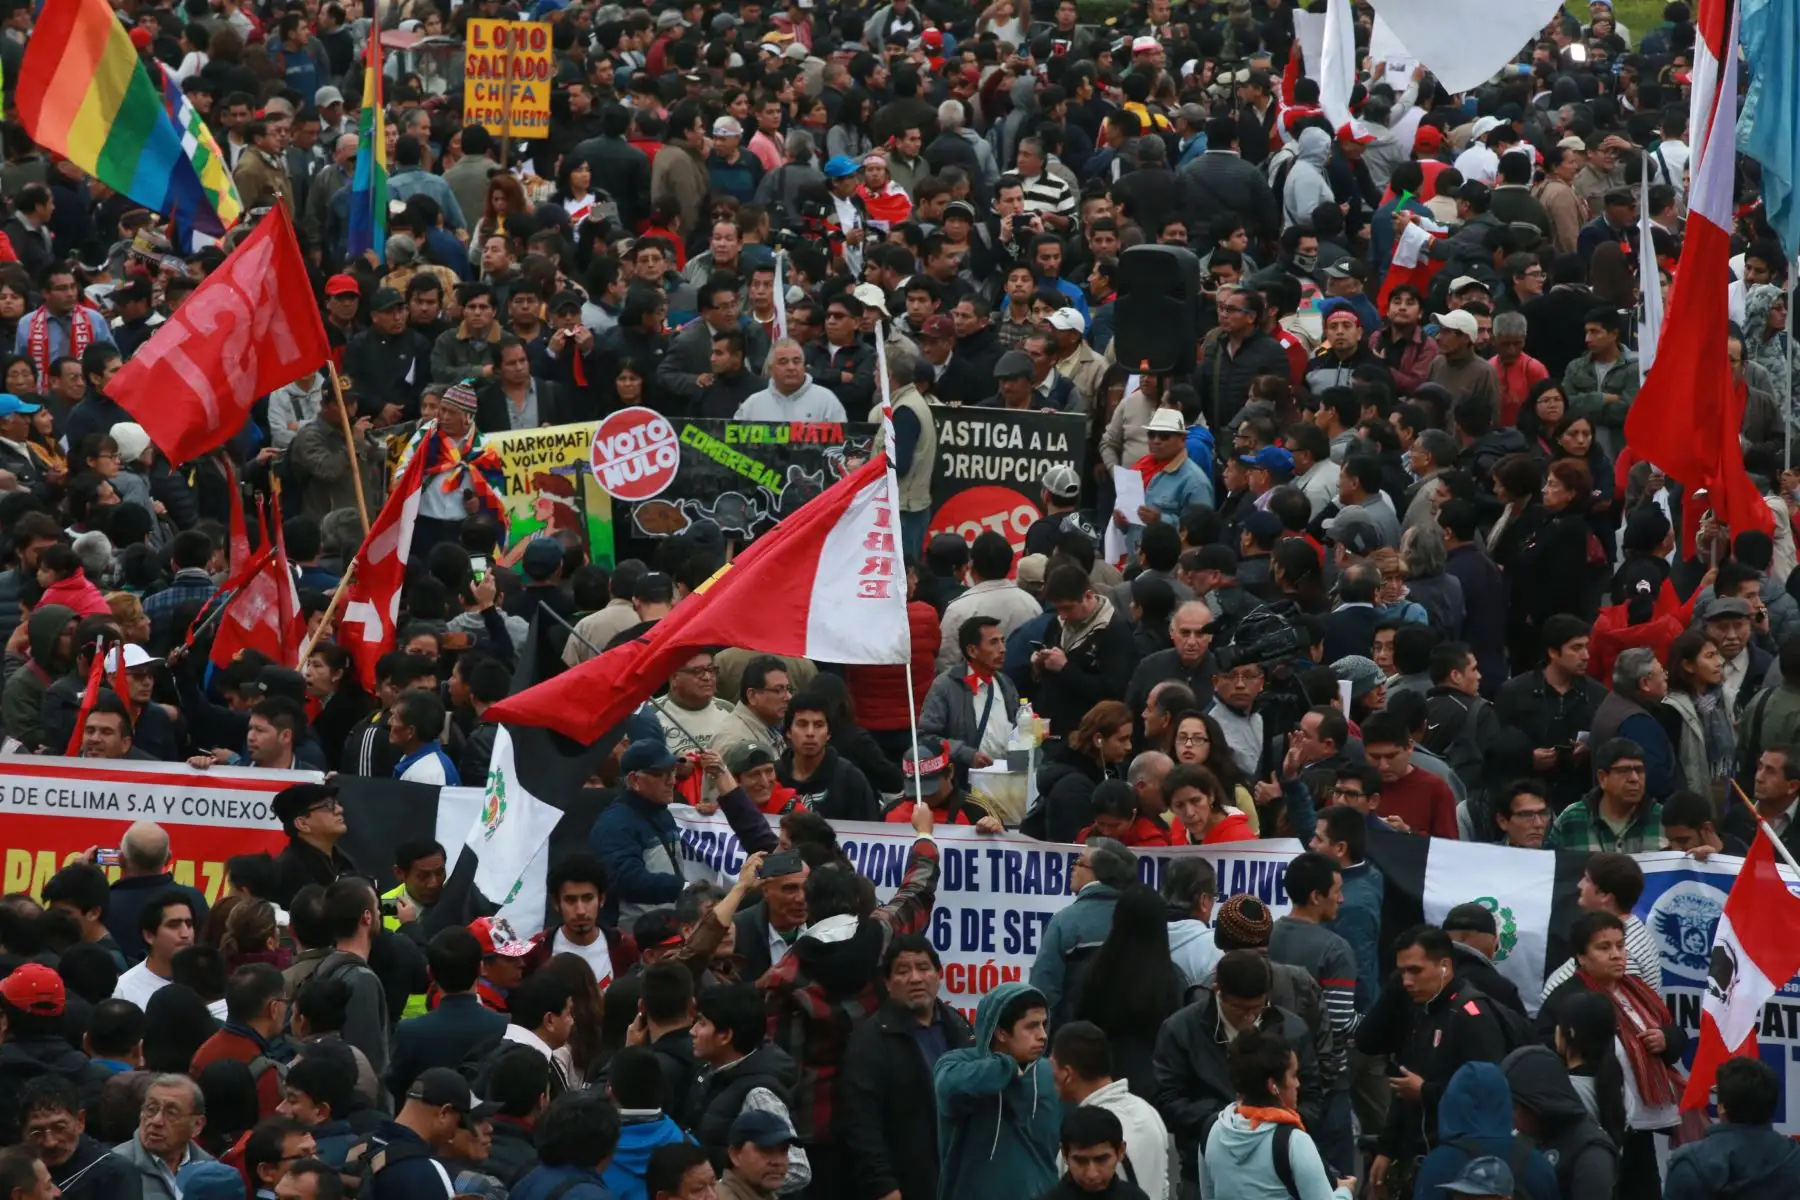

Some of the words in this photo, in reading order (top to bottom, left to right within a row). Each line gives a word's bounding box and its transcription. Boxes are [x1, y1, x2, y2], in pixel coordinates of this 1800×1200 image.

[466, 53, 549, 81] SALTADO
[465, 108, 551, 126] AEROUERTO
[502, 431, 591, 455] NARKOMAFI
[596, 418, 669, 463] VOTO
[936, 420, 1024, 450] ASTIGA
[1029, 431, 1041, 450] A
[1047, 432, 1068, 452] LA
[603, 446, 677, 490] NULO
[12, 786, 38, 806] DE
[45, 788, 119, 811] CELIMA
[127, 794, 156, 813] S.A
[163, 796, 176, 815] Y
[181, 797, 278, 821] CONEXOS
[943, 847, 979, 892] DE
[960, 908, 996, 953] DE
[1003, 909, 1054, 955] SET
[939, 959, 1021, 995] CIÓN
